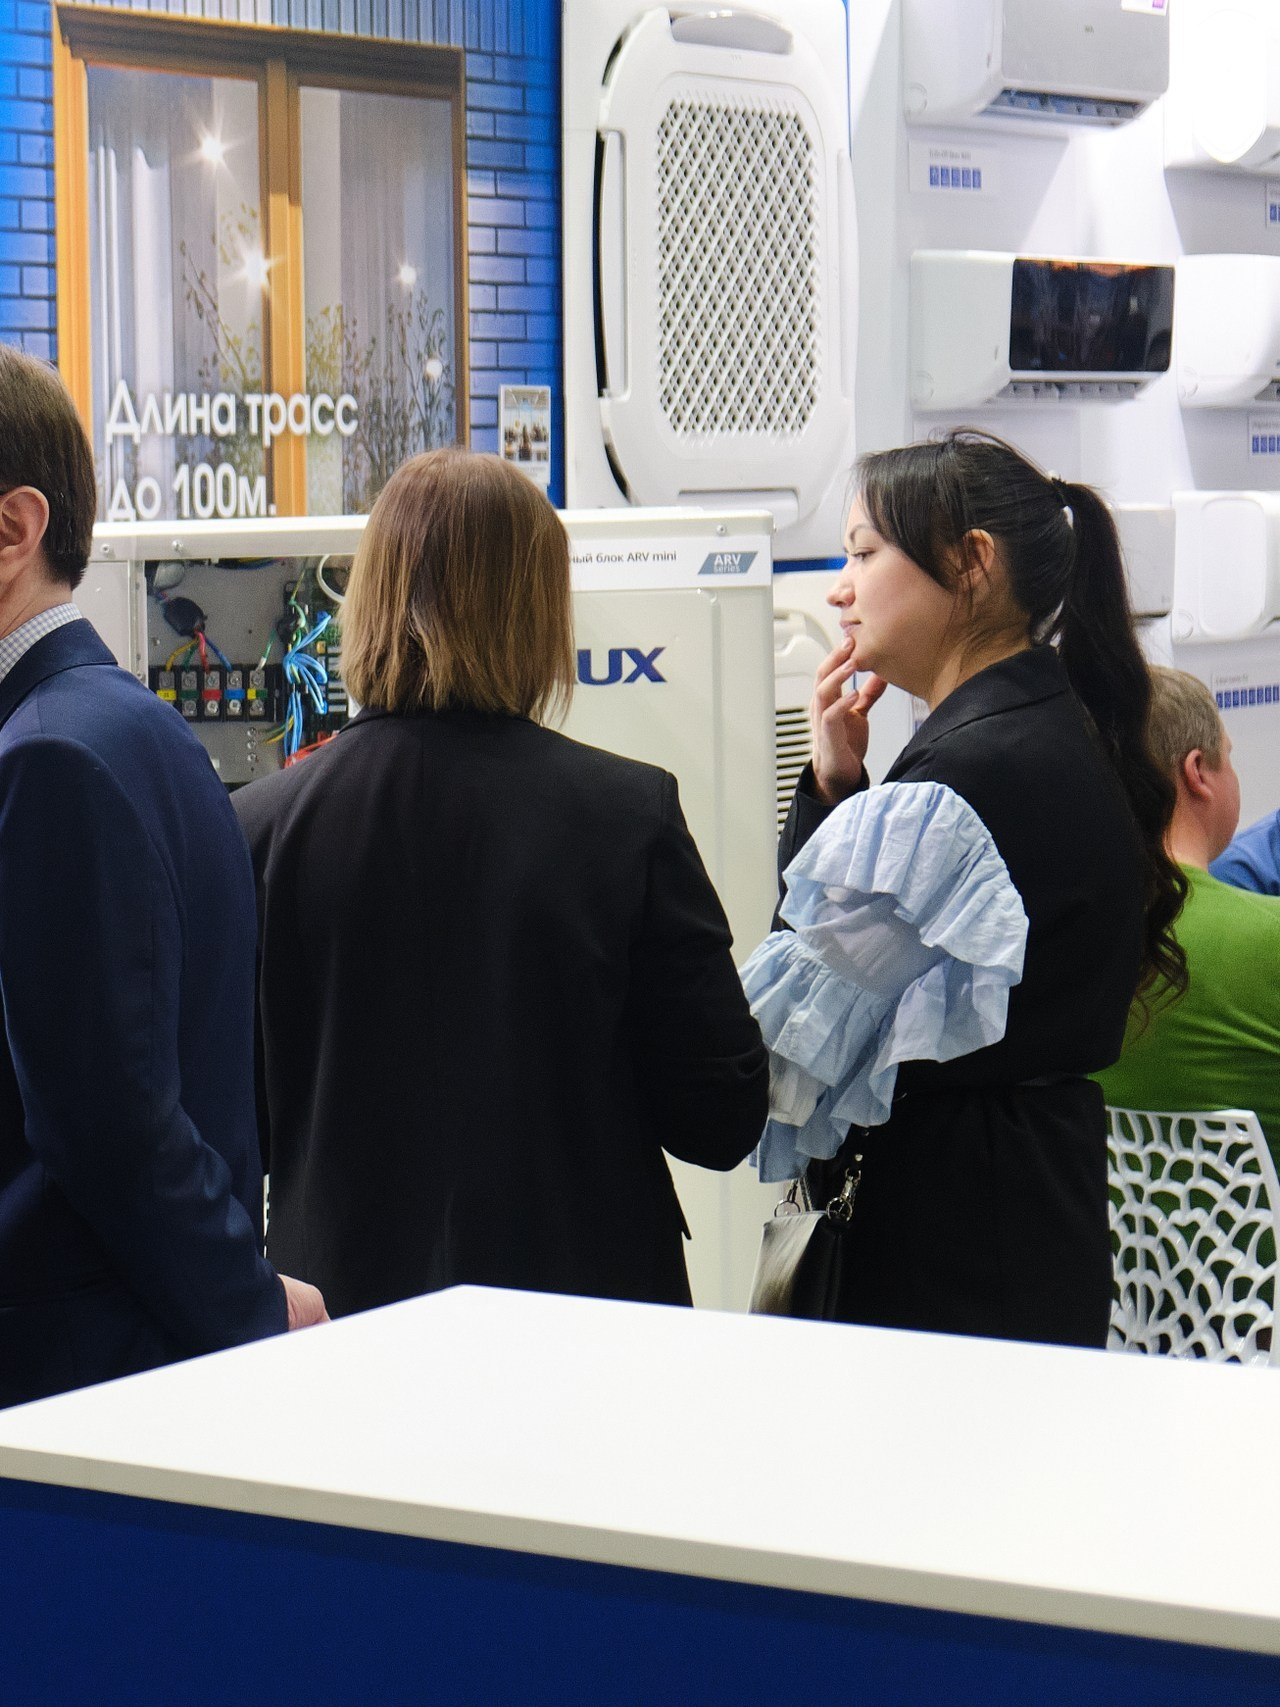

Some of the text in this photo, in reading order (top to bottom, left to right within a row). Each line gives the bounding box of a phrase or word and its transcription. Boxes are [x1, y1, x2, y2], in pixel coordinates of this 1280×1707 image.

[106, 379, 359, 448] Длина трасс
[107, 462, 277, 523] до 100м.
[596, 552, 624, 564] блок
[627, 551, 649, 563] ARV
[652, 550, 677, 562] mini
[714, 553, 741, 566] ARV
